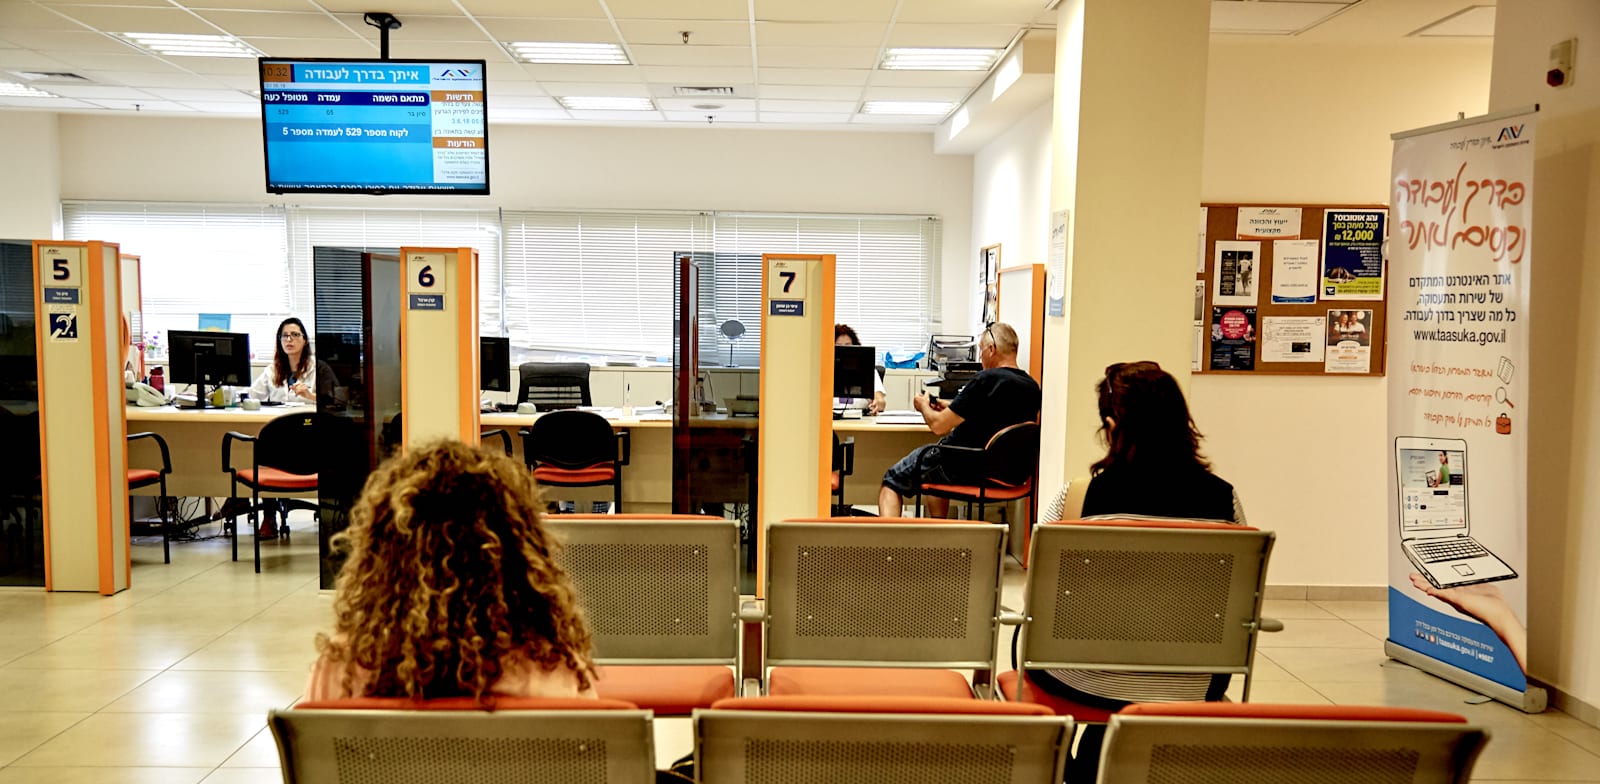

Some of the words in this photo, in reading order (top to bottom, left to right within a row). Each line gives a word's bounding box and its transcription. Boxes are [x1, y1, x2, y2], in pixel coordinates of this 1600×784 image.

[304, 67, 350, 80] לעבודה
[353, 70, 386, 82] בדרך
[388, 70, 419, 83] איתך
[282, 92, 308, 102] מטופל
[318, 94, 340, 102] עמדה
[282, 127, 289, 136] 5
[316, 128, 343, 136] לעמדה
[346, 128, 362, 136] 529
[390, 128, 408, 138] לקוח
[1397, 161, 1467, 216] לעבודה
[1463, 179, 1525, 224] בדרך
[1332, 222, 1346, 230] בסך
[1347, 222, 1364, 230] מענק
[1365, 221, 1378, 230] קבל
[1401, 206, 1456, 251] לאתר
[1342, 230, 1374, 242] 12,000
[1452, 225, 1526, 264] נכנסים
[53, 259, 70, 280] 5
[418, 265, 434, 287] 6
[780, 272, 796, 293] 7
[1410, 276, 1444, 290] המתקדם
[1446, 274, 1490, 286] האינטרנט
[1492, 274, 1512, 284] אתר
[1416, 293, 1456, 306] התעסוקה,
[1459, 293, 1486, 304] שירות
[1489, 290, 1504, 304] של
[1404, 308, 1434, 322] לעבודה.
[1436, 310, 1454, 324] בדרך
[1457, 310, 1486, 325] שצריך
[1489, 310, 1503, 321] מה
[1505, 308, 1516, 322] כל
[1414, 328, 1506, 346] www.taasuka.gov.il
